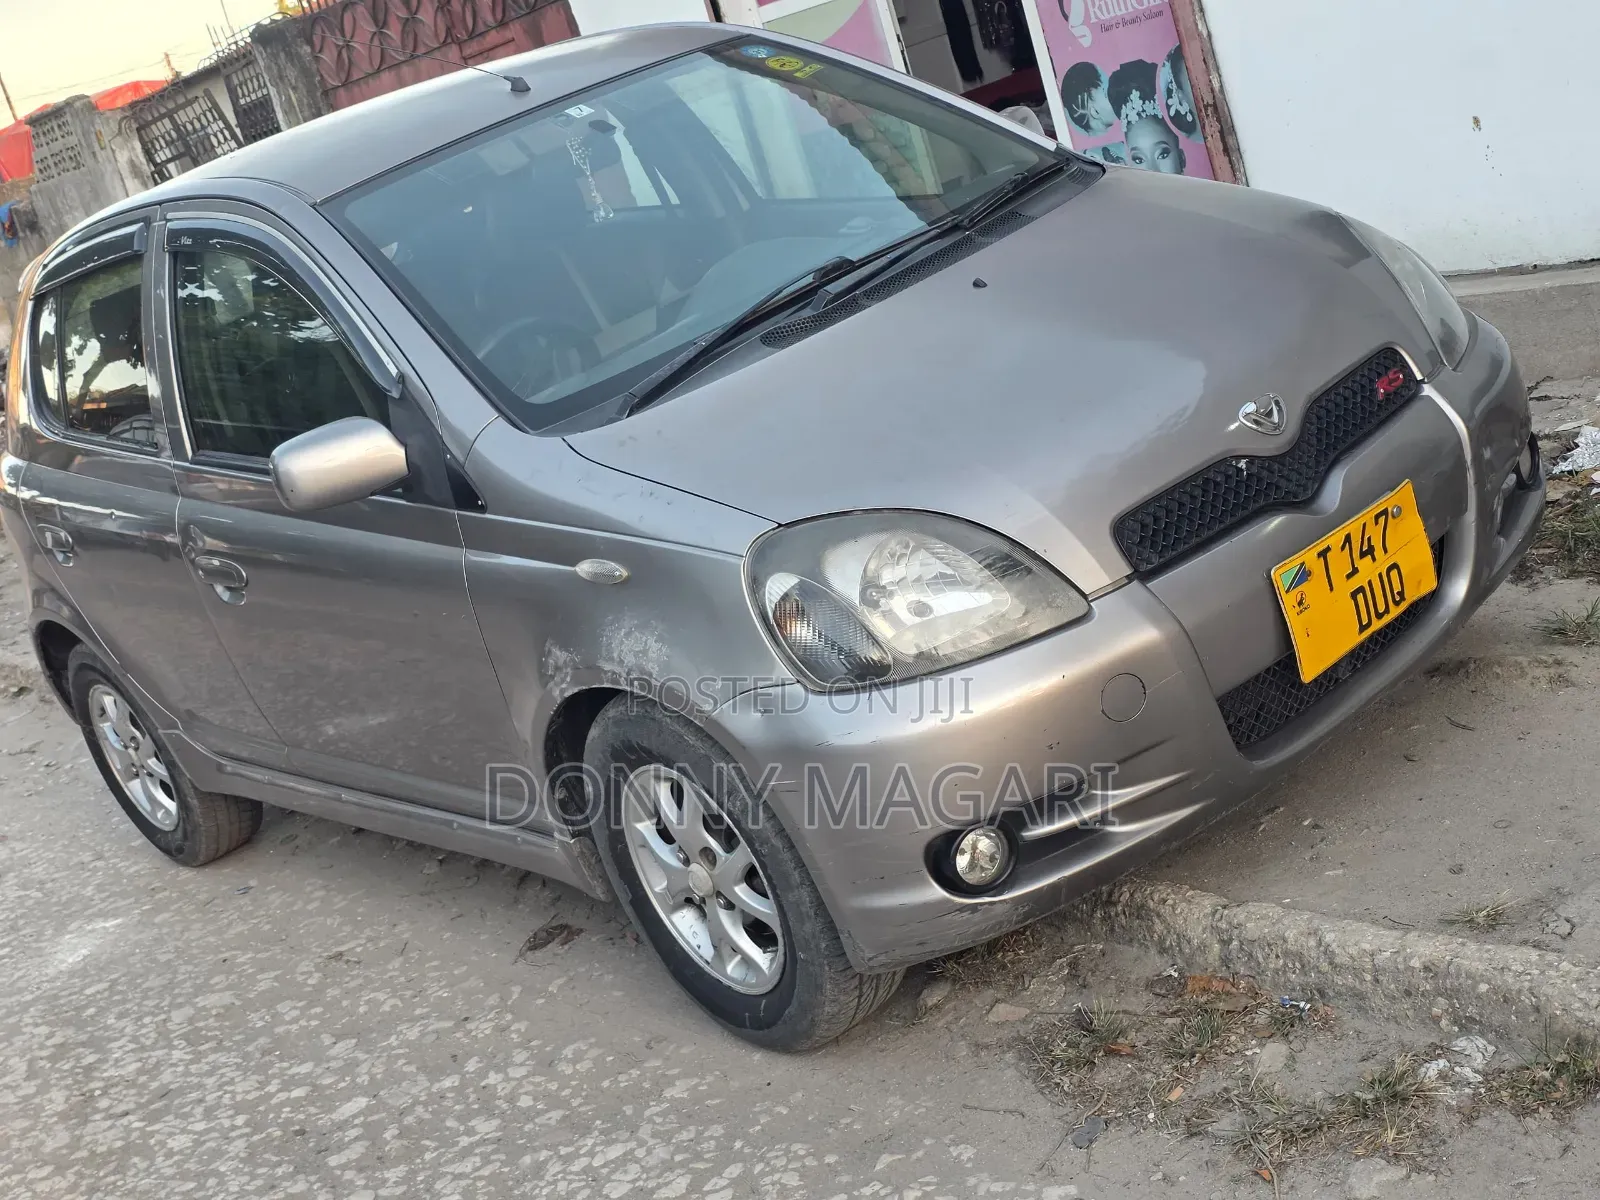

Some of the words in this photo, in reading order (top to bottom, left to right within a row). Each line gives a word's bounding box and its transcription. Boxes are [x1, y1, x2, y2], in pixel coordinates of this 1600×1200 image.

[1100, 22, 1114, 33] Hair
[1115, 20, 1121, 29] &
[1121, 15, 1143, 28] Beauty
[1376, 368, 1404, 400] RS
[1316, 544, 1334, 592] T
[1340, 507, 1389, 581] 147
[1350, 562, 1406, 635] DUQ
